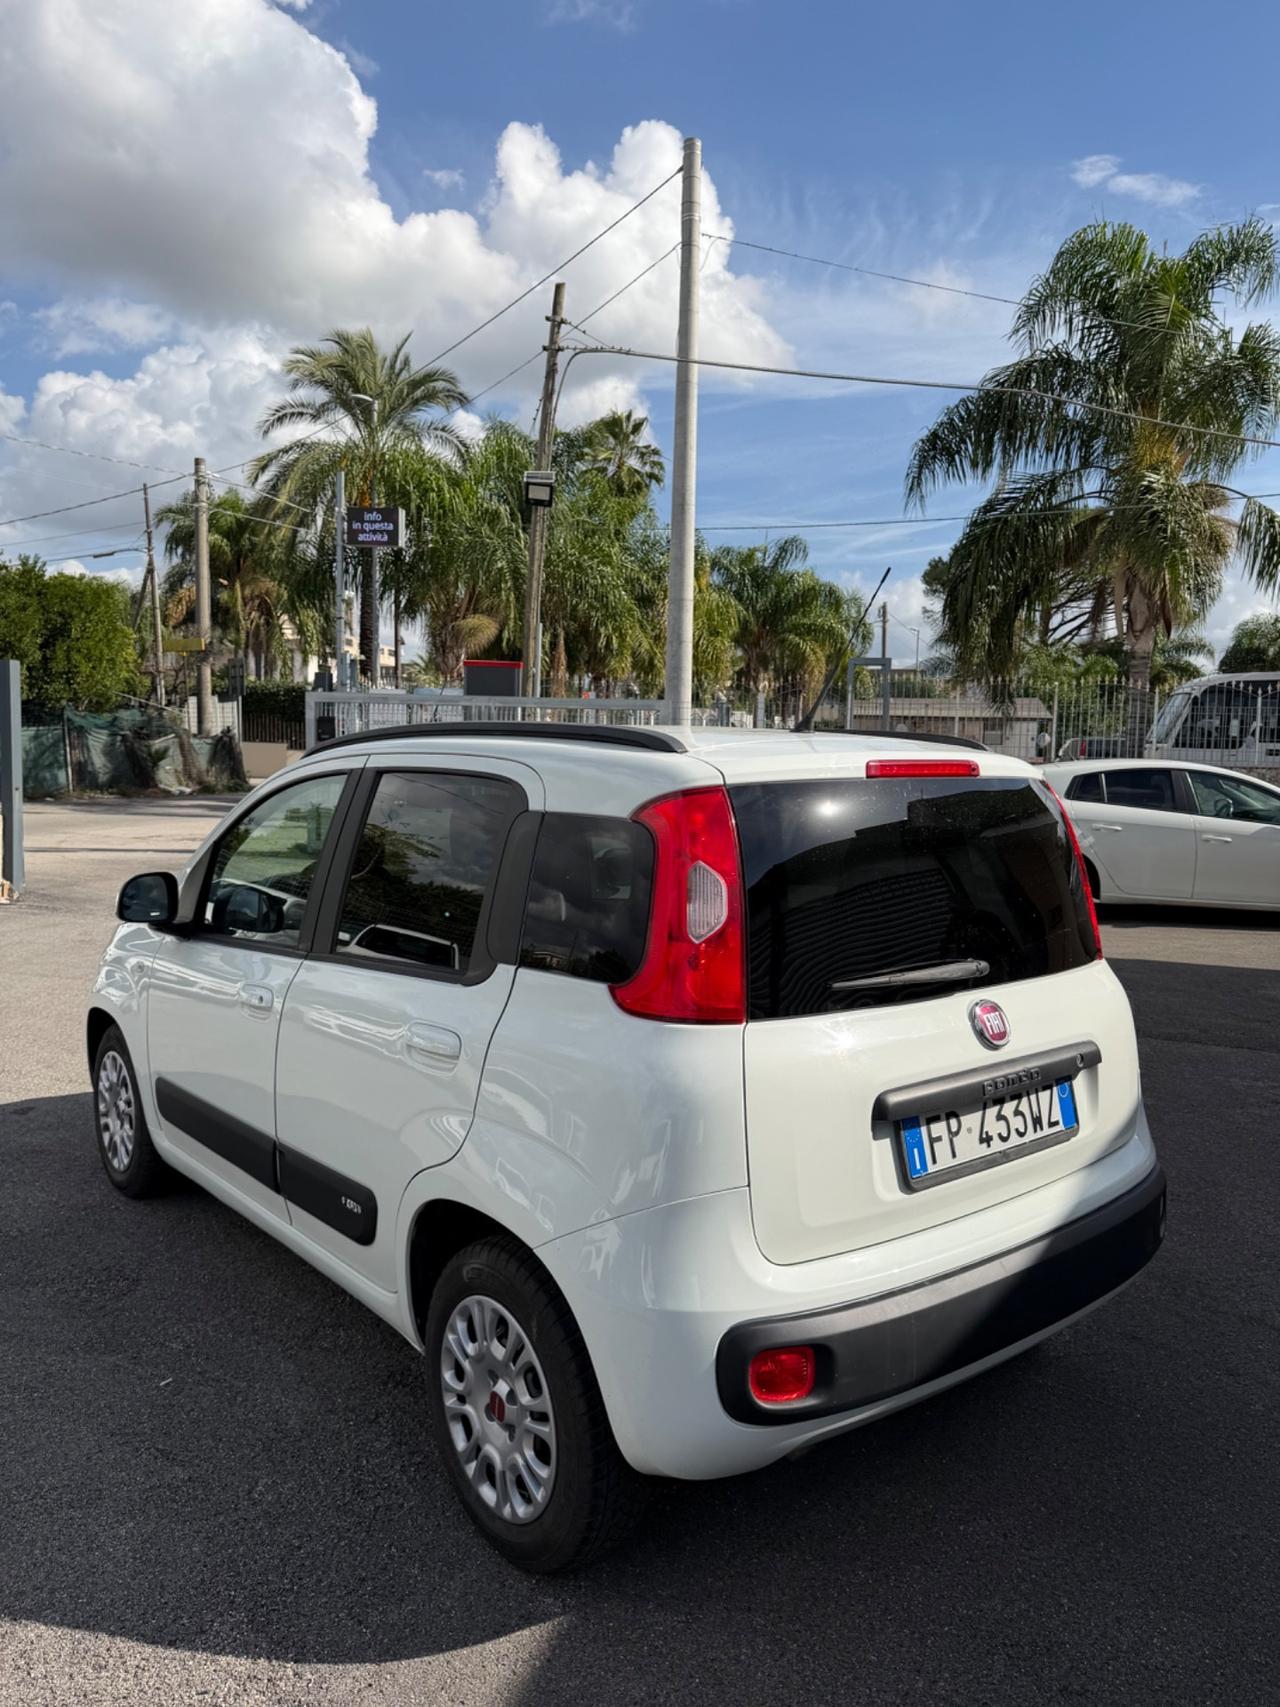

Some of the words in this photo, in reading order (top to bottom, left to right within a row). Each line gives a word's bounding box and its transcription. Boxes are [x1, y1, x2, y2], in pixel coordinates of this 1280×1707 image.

[363, 522, 394, 531] questa
[358, 531, 388, 541] attività
[983, 1012, 1005, 1035] FIAT
[925, 1110, 962, 1165] FP
[978, 1083, 1061, 1148] 433WZ
